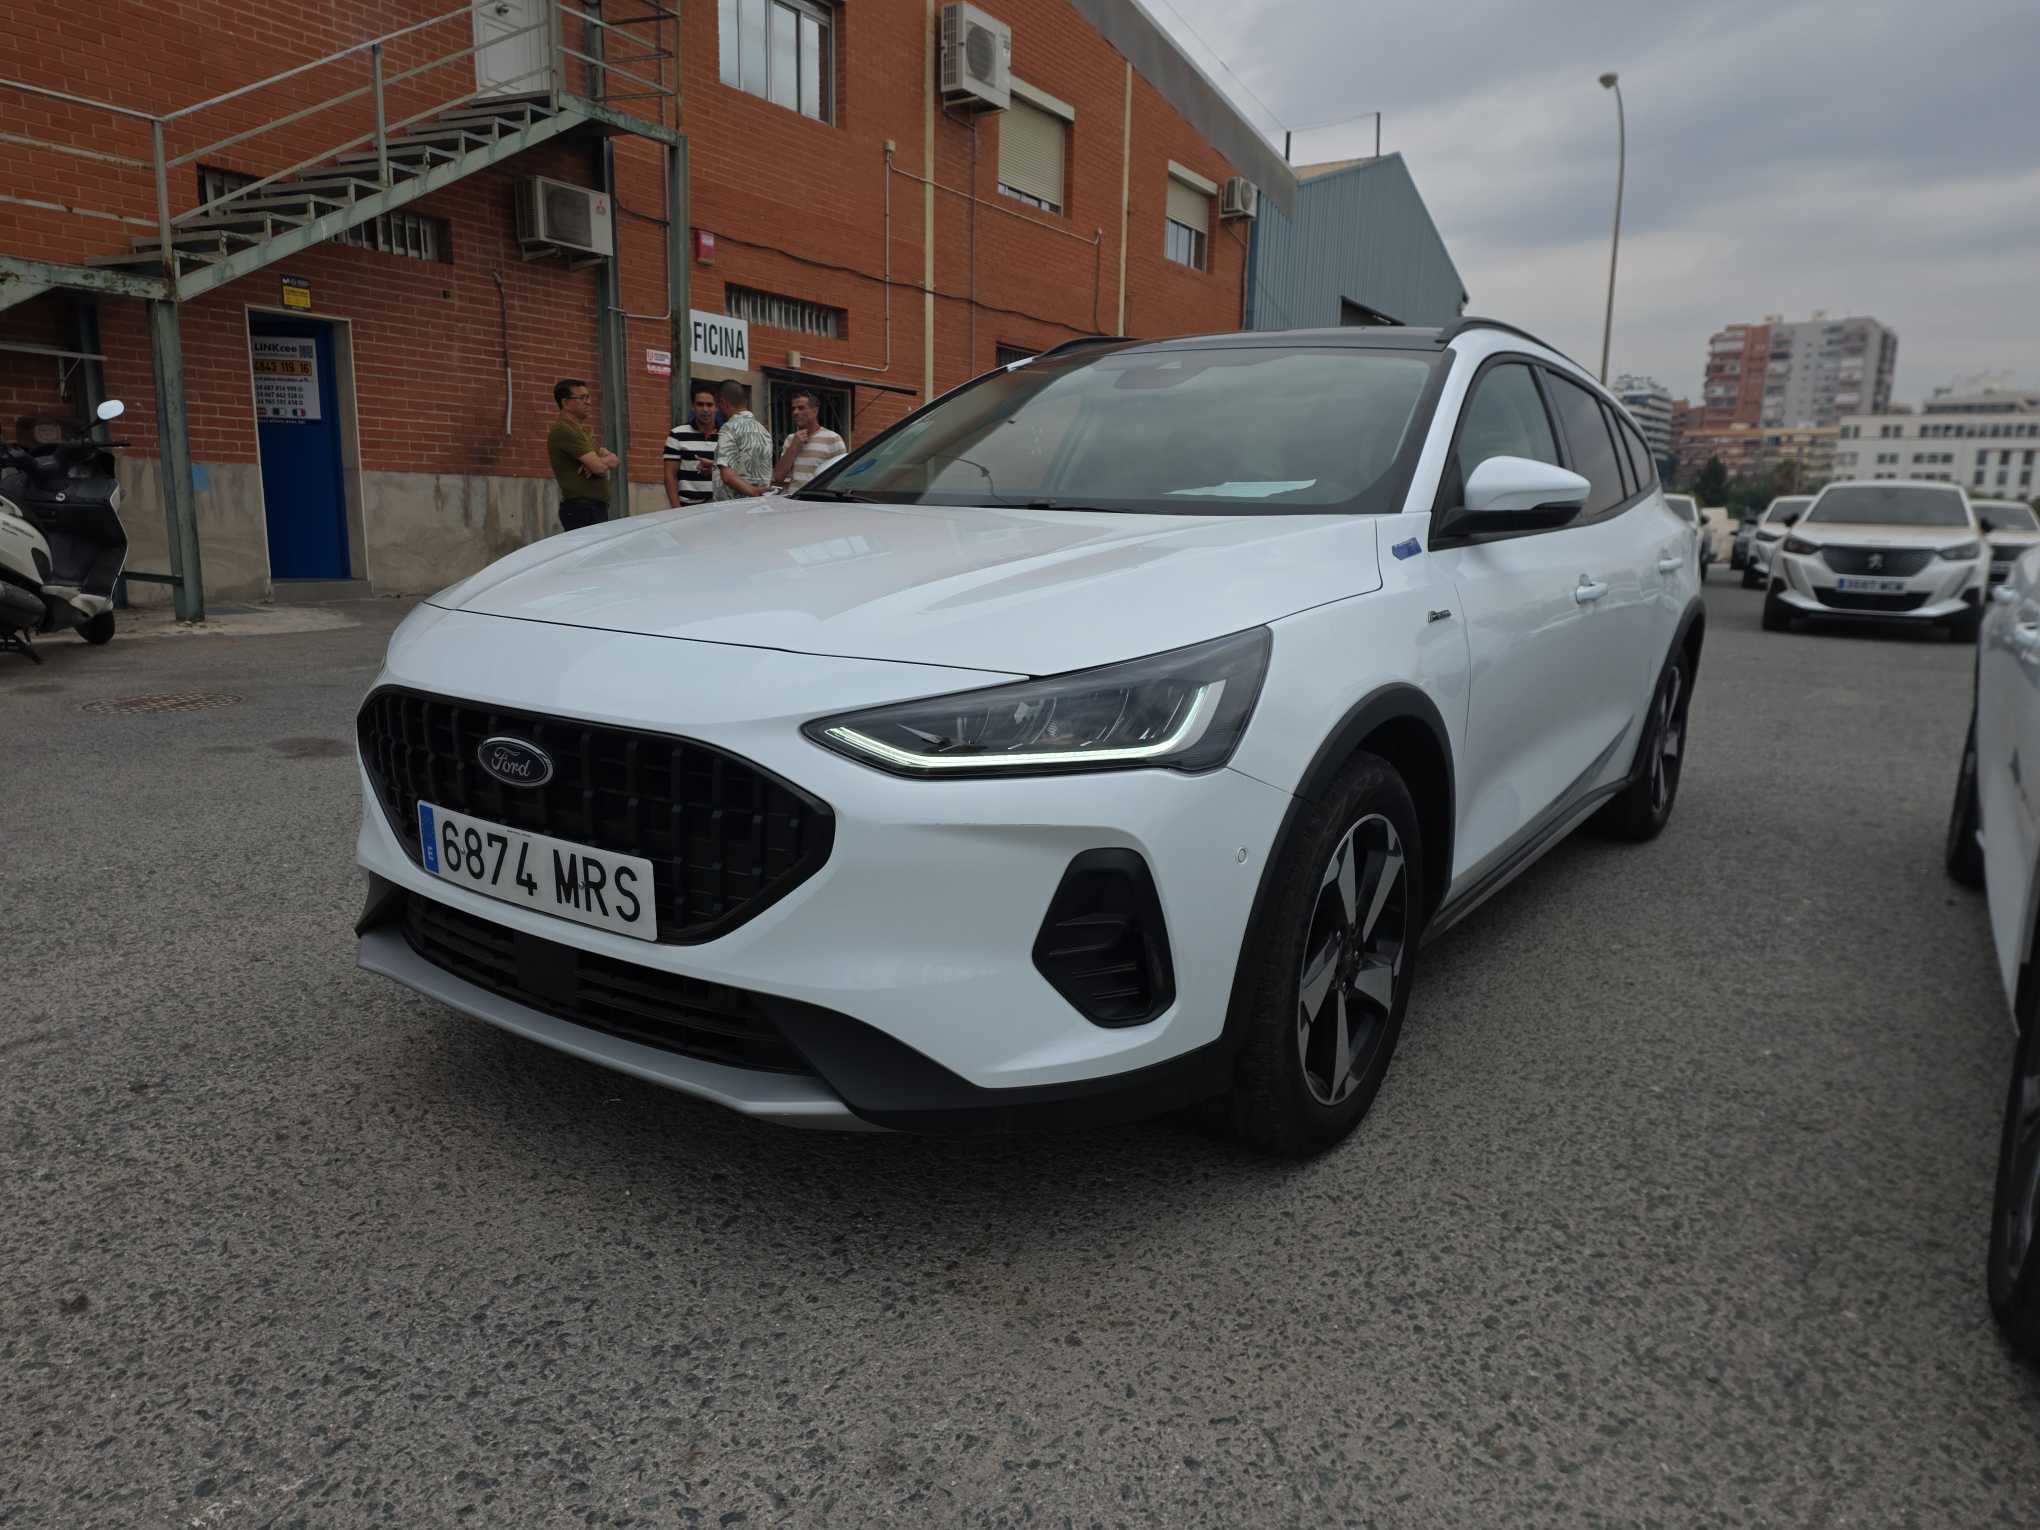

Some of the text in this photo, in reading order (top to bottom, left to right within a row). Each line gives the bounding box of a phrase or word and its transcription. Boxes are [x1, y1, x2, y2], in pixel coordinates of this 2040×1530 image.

[692, 320, 746, 361] FICINA
[491, 746, 531, 777] Ford
[441, 820, 538, 897] 6874
[553, 849, 641, 923] MRS
